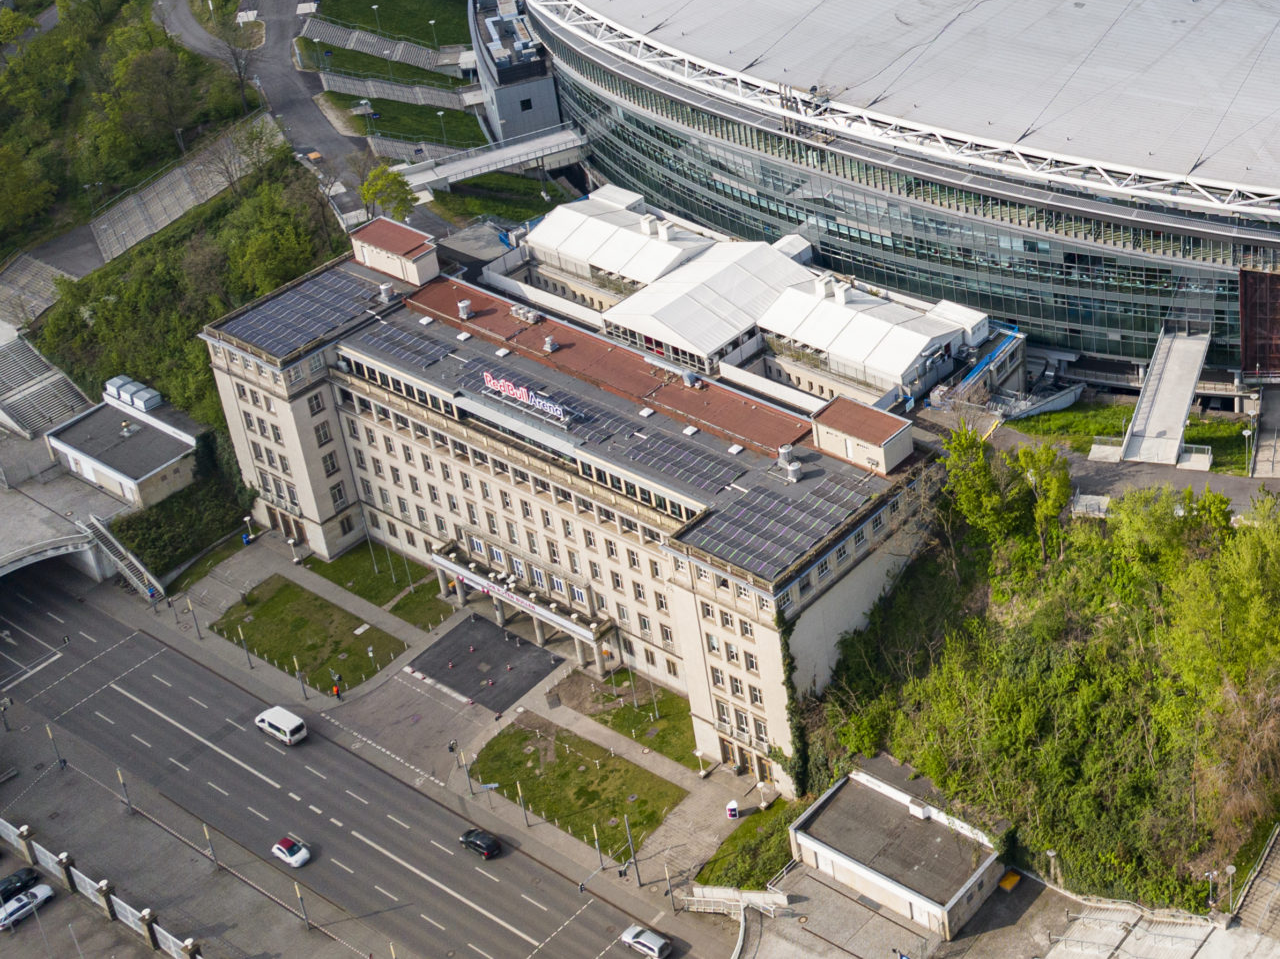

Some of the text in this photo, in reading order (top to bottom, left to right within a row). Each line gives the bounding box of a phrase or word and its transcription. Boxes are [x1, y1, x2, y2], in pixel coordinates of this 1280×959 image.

[484, 371, 563, 418] Red Bull Arena
